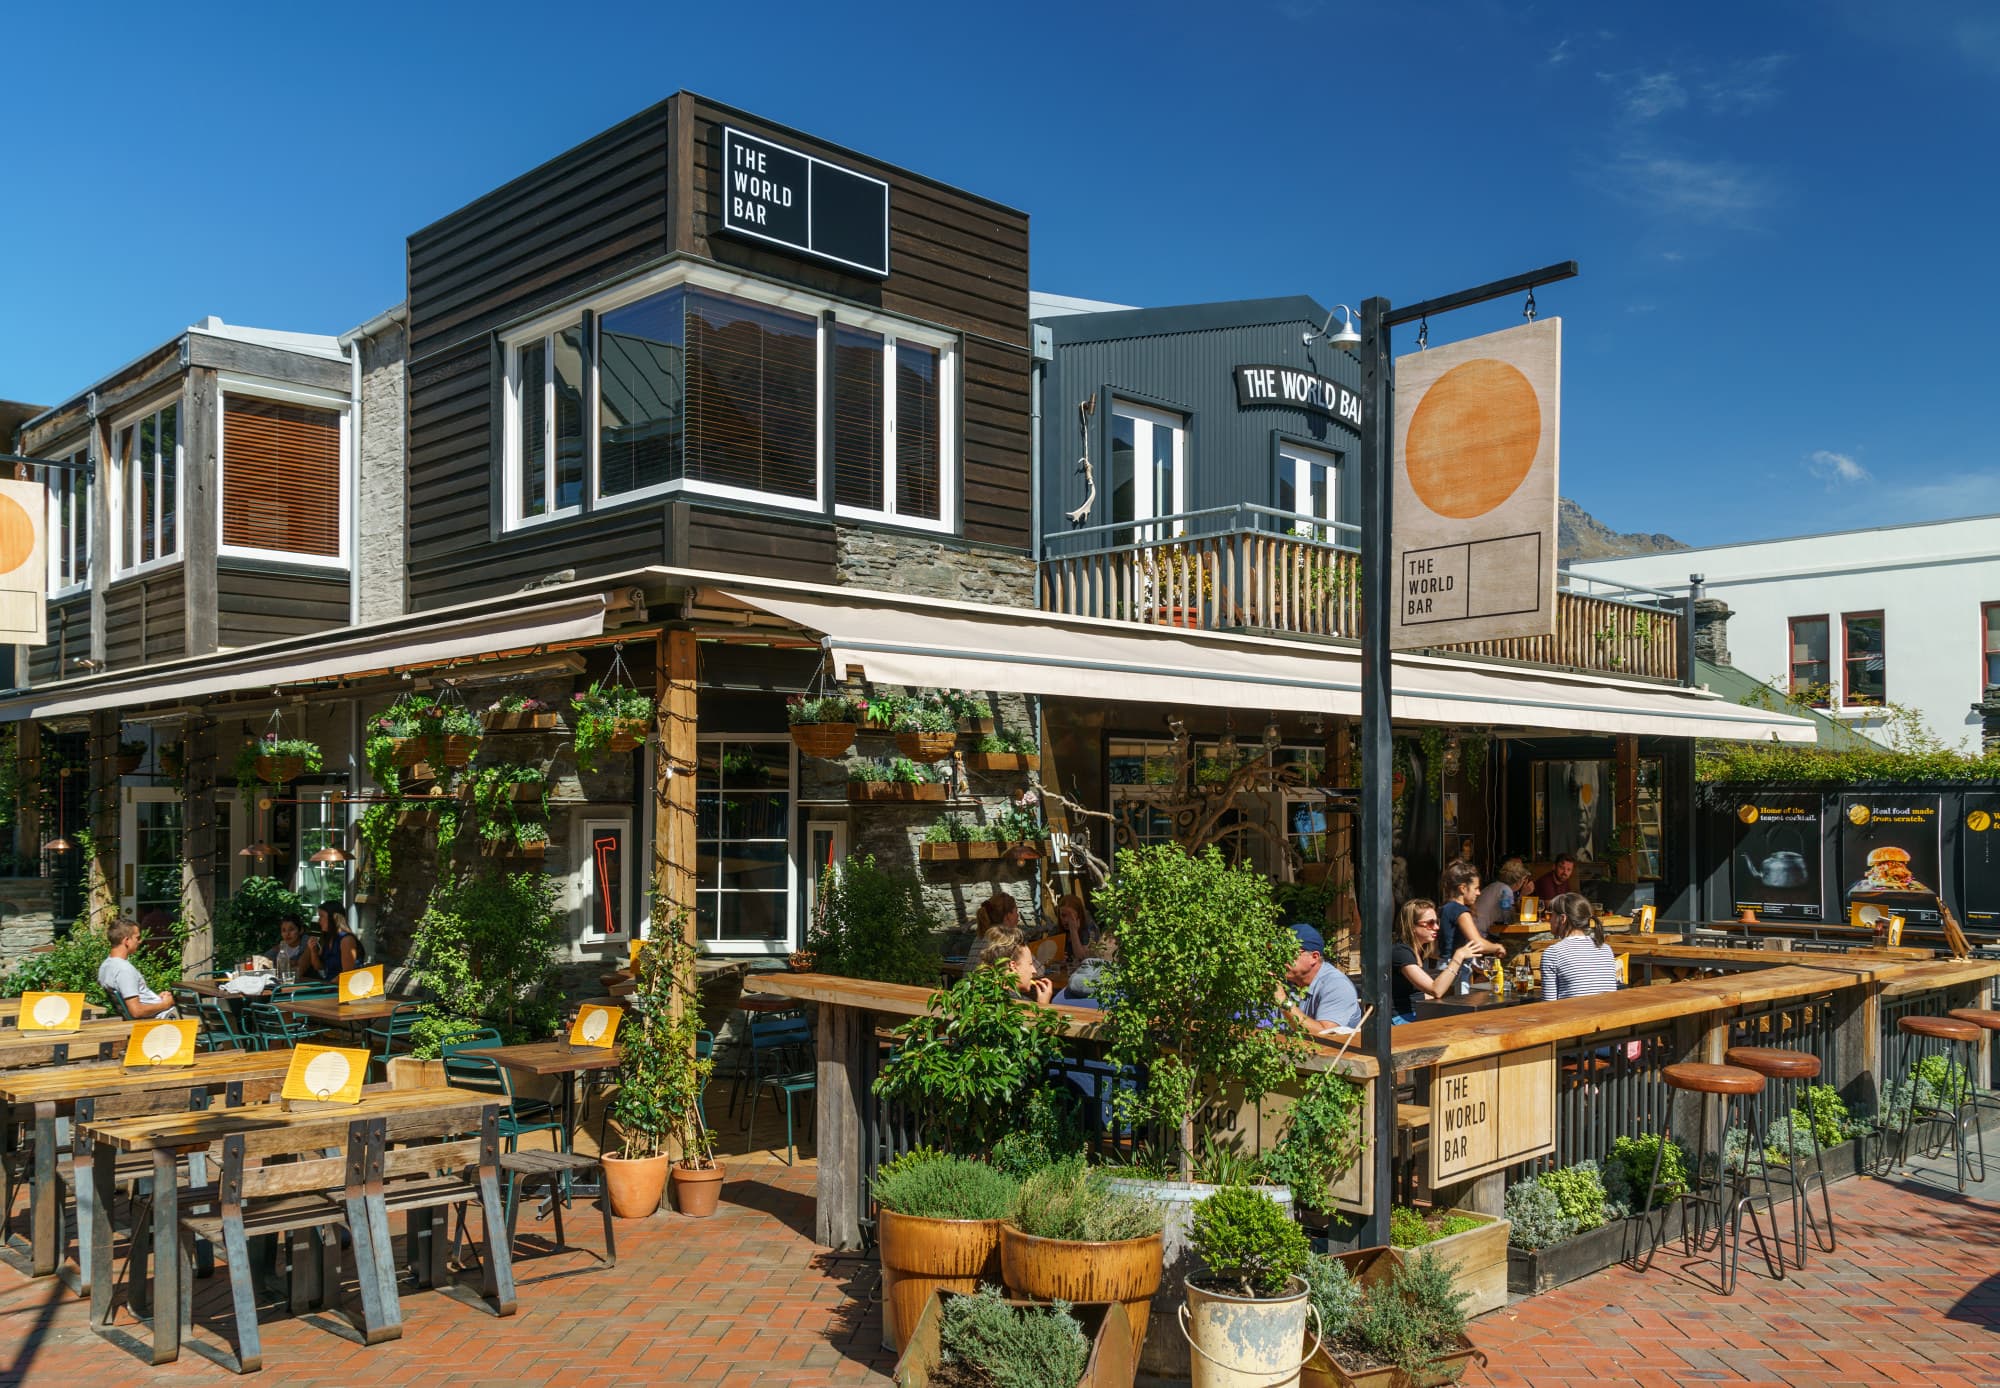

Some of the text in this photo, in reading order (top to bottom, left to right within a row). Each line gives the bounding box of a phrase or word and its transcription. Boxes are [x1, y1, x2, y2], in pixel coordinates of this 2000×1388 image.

[734, 144, 767, 174] THE
[734, 170, 792, 207] WORLD
[734, 196, 767, 226] BAR
[1243, 369, 1362, 425] THE WORLD BA
[1409, 558, 1434, 576] THE
[1408, 575, 1454, 596] WORLD
[1408, 598, 1433, 616] BAR
[1872, 807, 1935, 815] Real food made
[1893, 815, 1926, 823] scratch.
[1445, 1075, 1468, 1102] THE
[1445, 1101, 1486, 1132] WORLD
[1444, 1135, 1467, 1162] BAR
